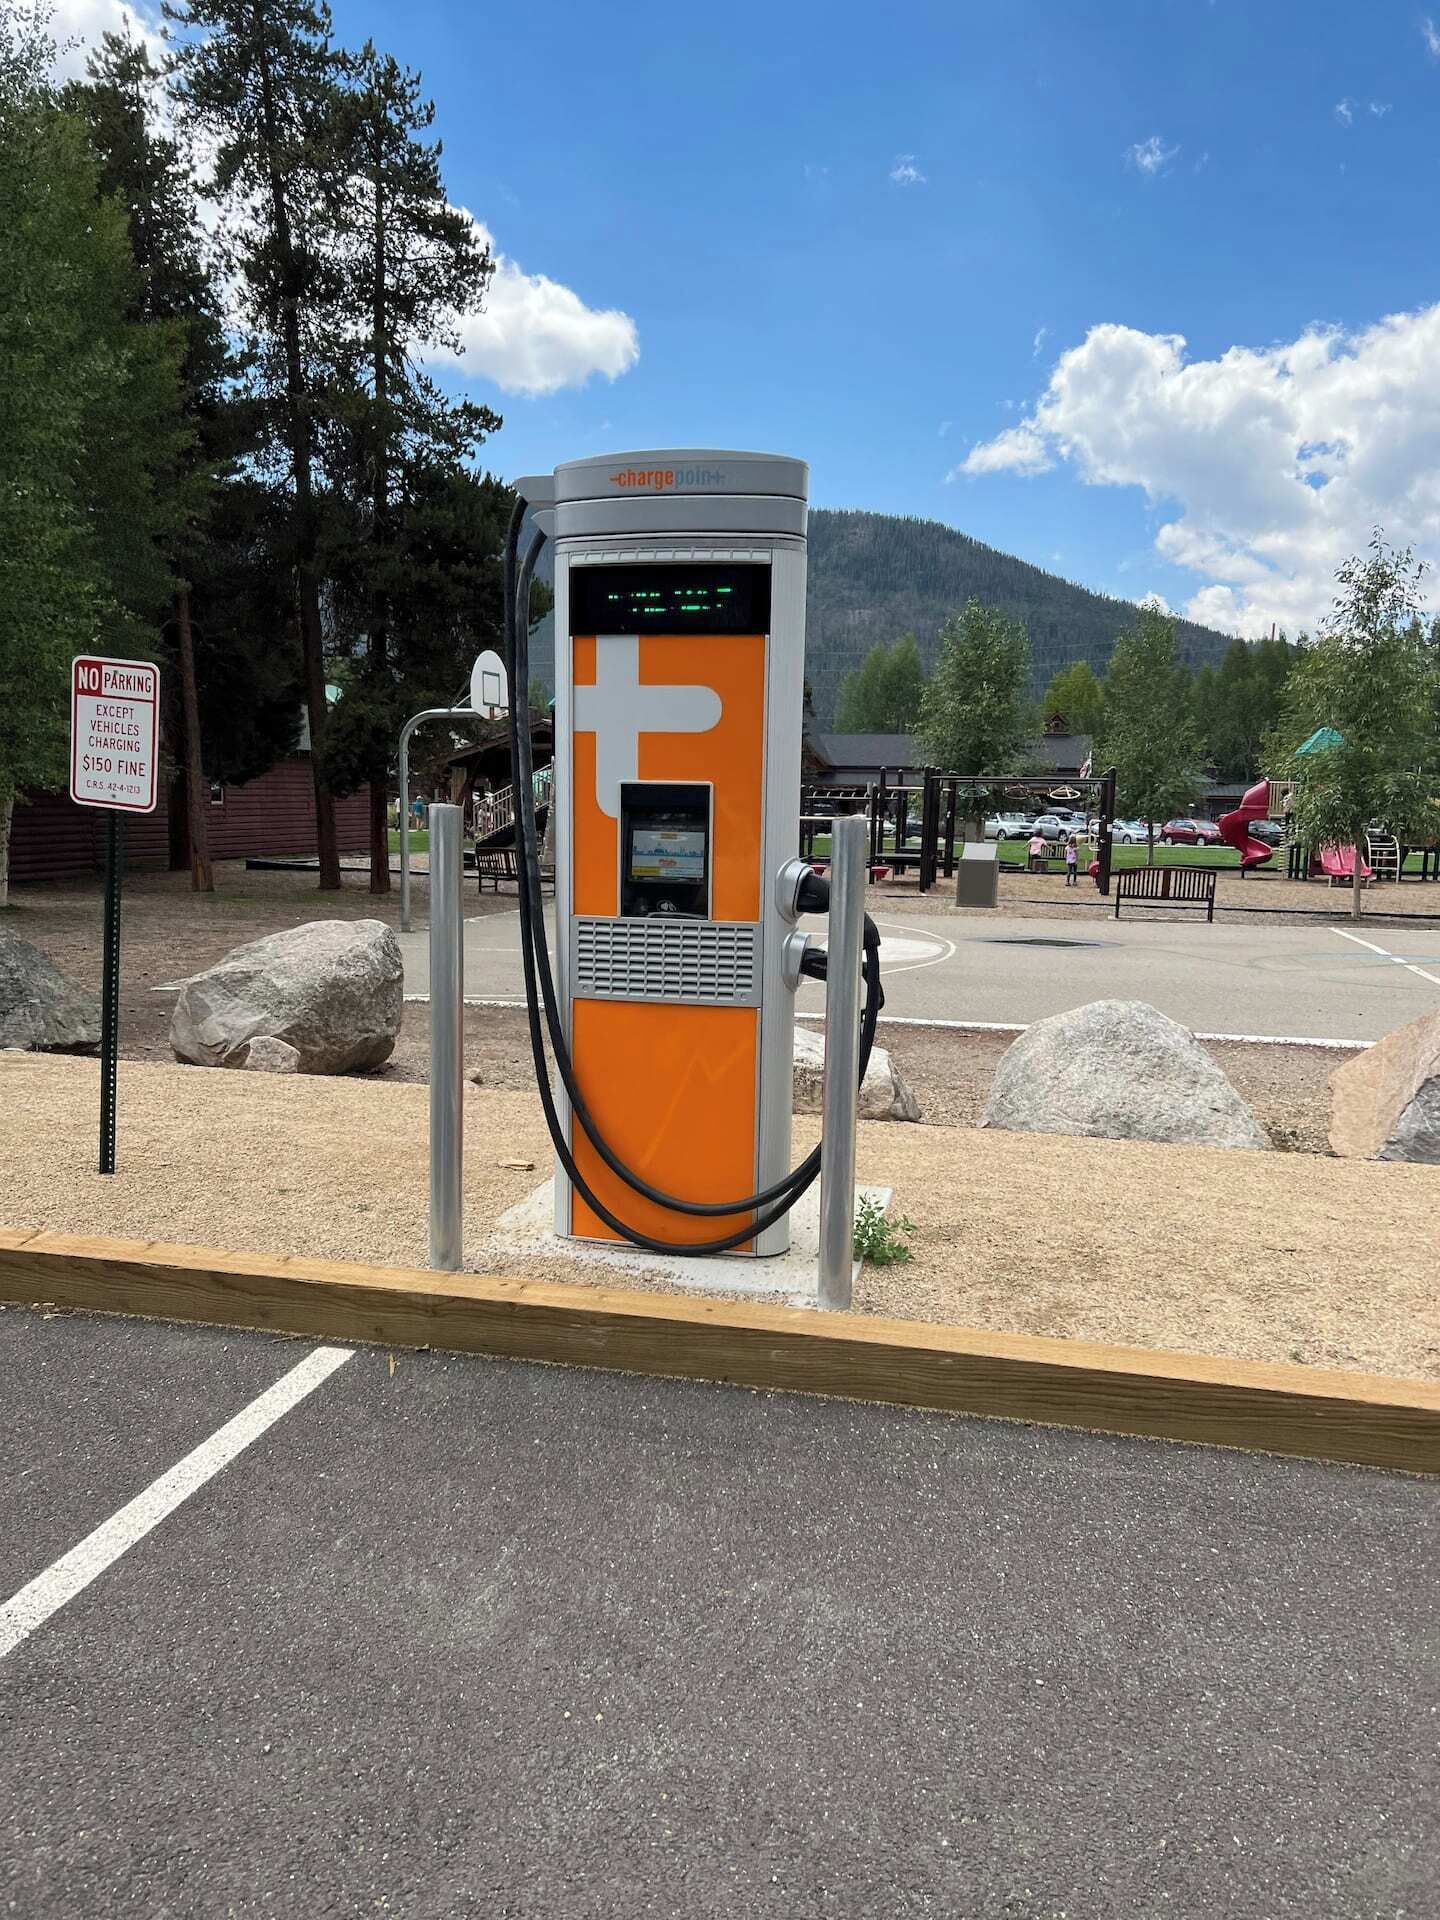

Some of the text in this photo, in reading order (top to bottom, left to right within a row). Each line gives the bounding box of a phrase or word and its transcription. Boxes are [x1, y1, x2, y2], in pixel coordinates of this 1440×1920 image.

[78, 666, 152, 694] NO PARKING
[96, 704, 134, 720] EXCEPT
[90, 720, 139, 736] VEHICLES
[88, 736, 140, 753] CHARGING
[83, 754, 146, 777] $150 FINE
